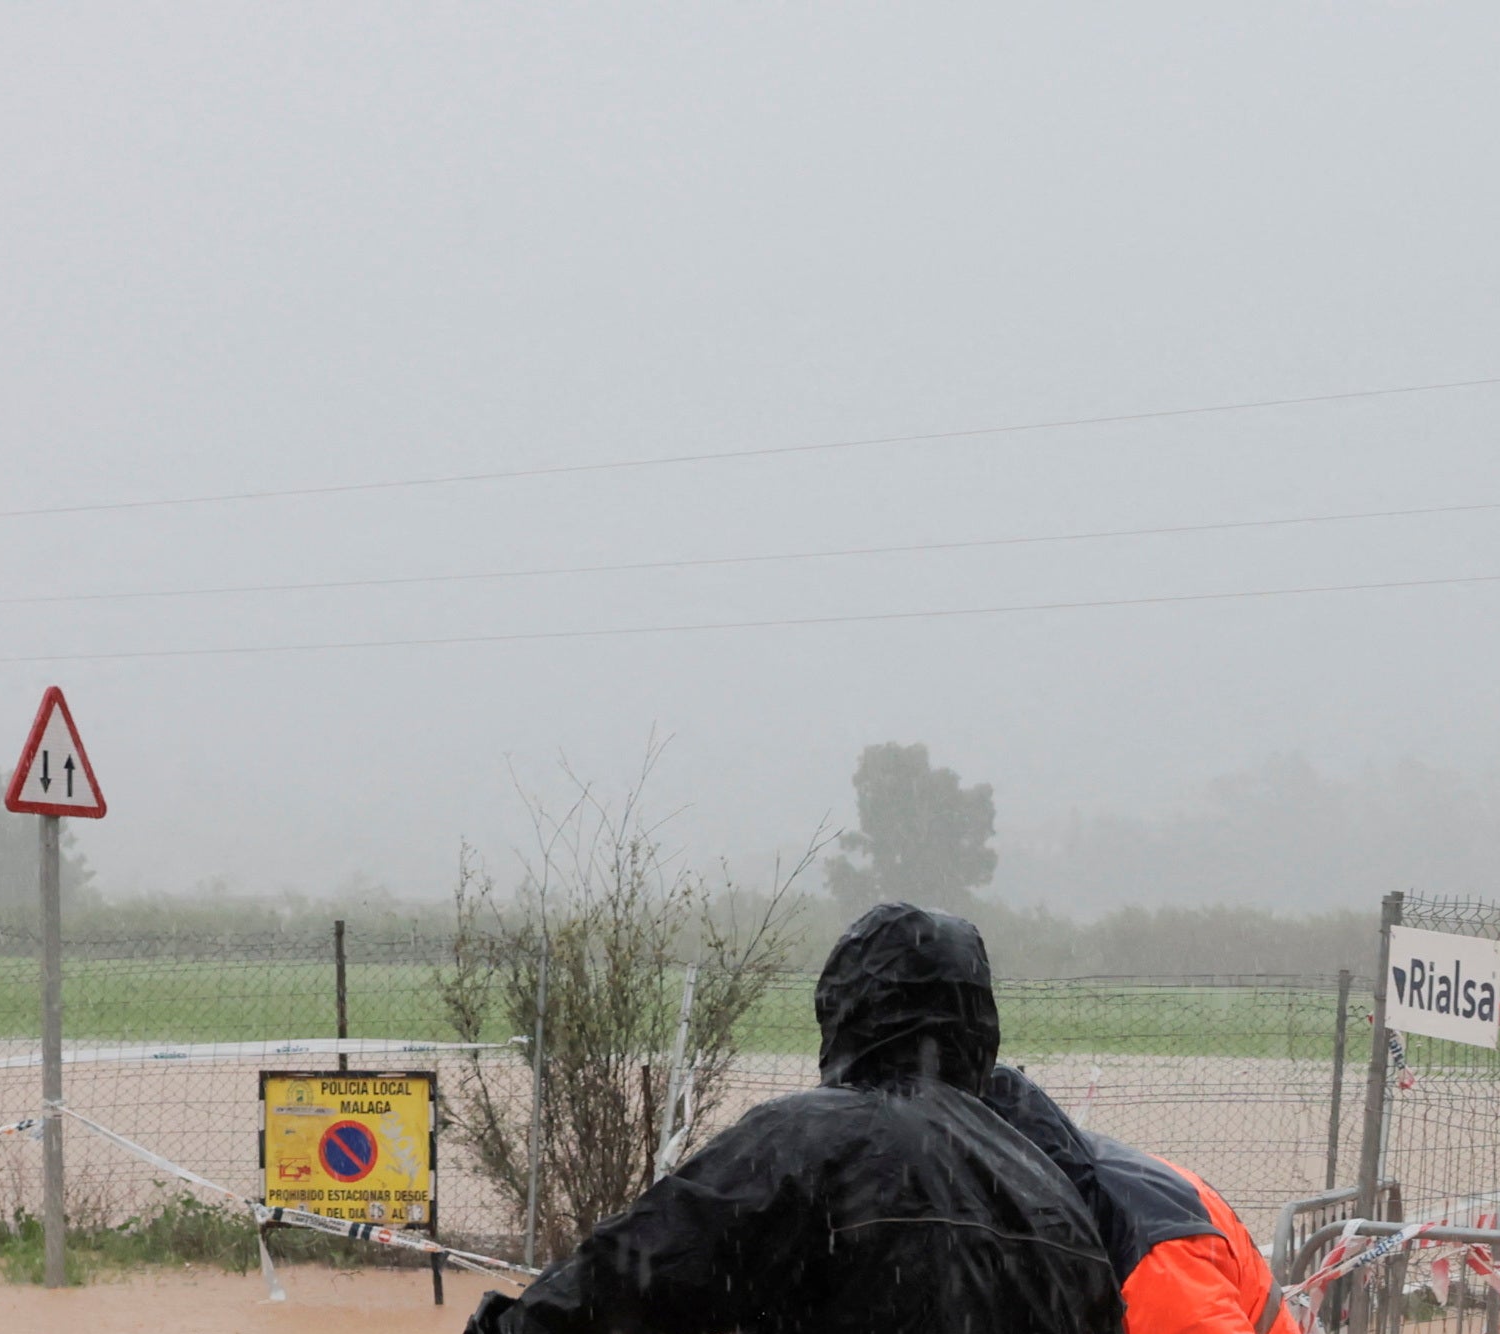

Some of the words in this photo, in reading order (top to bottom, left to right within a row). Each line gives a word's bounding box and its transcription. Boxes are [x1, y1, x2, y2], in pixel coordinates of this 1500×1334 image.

[1408, 958, 1495, 1023] Rialsa
[321, 1081, 369, 1096] POLICIA
[373, 1081, 412, 1096] LOCAL
[340, 1100, 392, 1114] MALAGA
[269, 1189, 324, 1201] PROHIBIDO
[328, 1189, 391, 1201] ESTACIONAR
[394, 1190, 429, 1201] DESDE
[326, 1207, 345, 1219] DEL
[349, 1207, 366, 1219] DIA
[392, 1208, 404, 1219] AL
